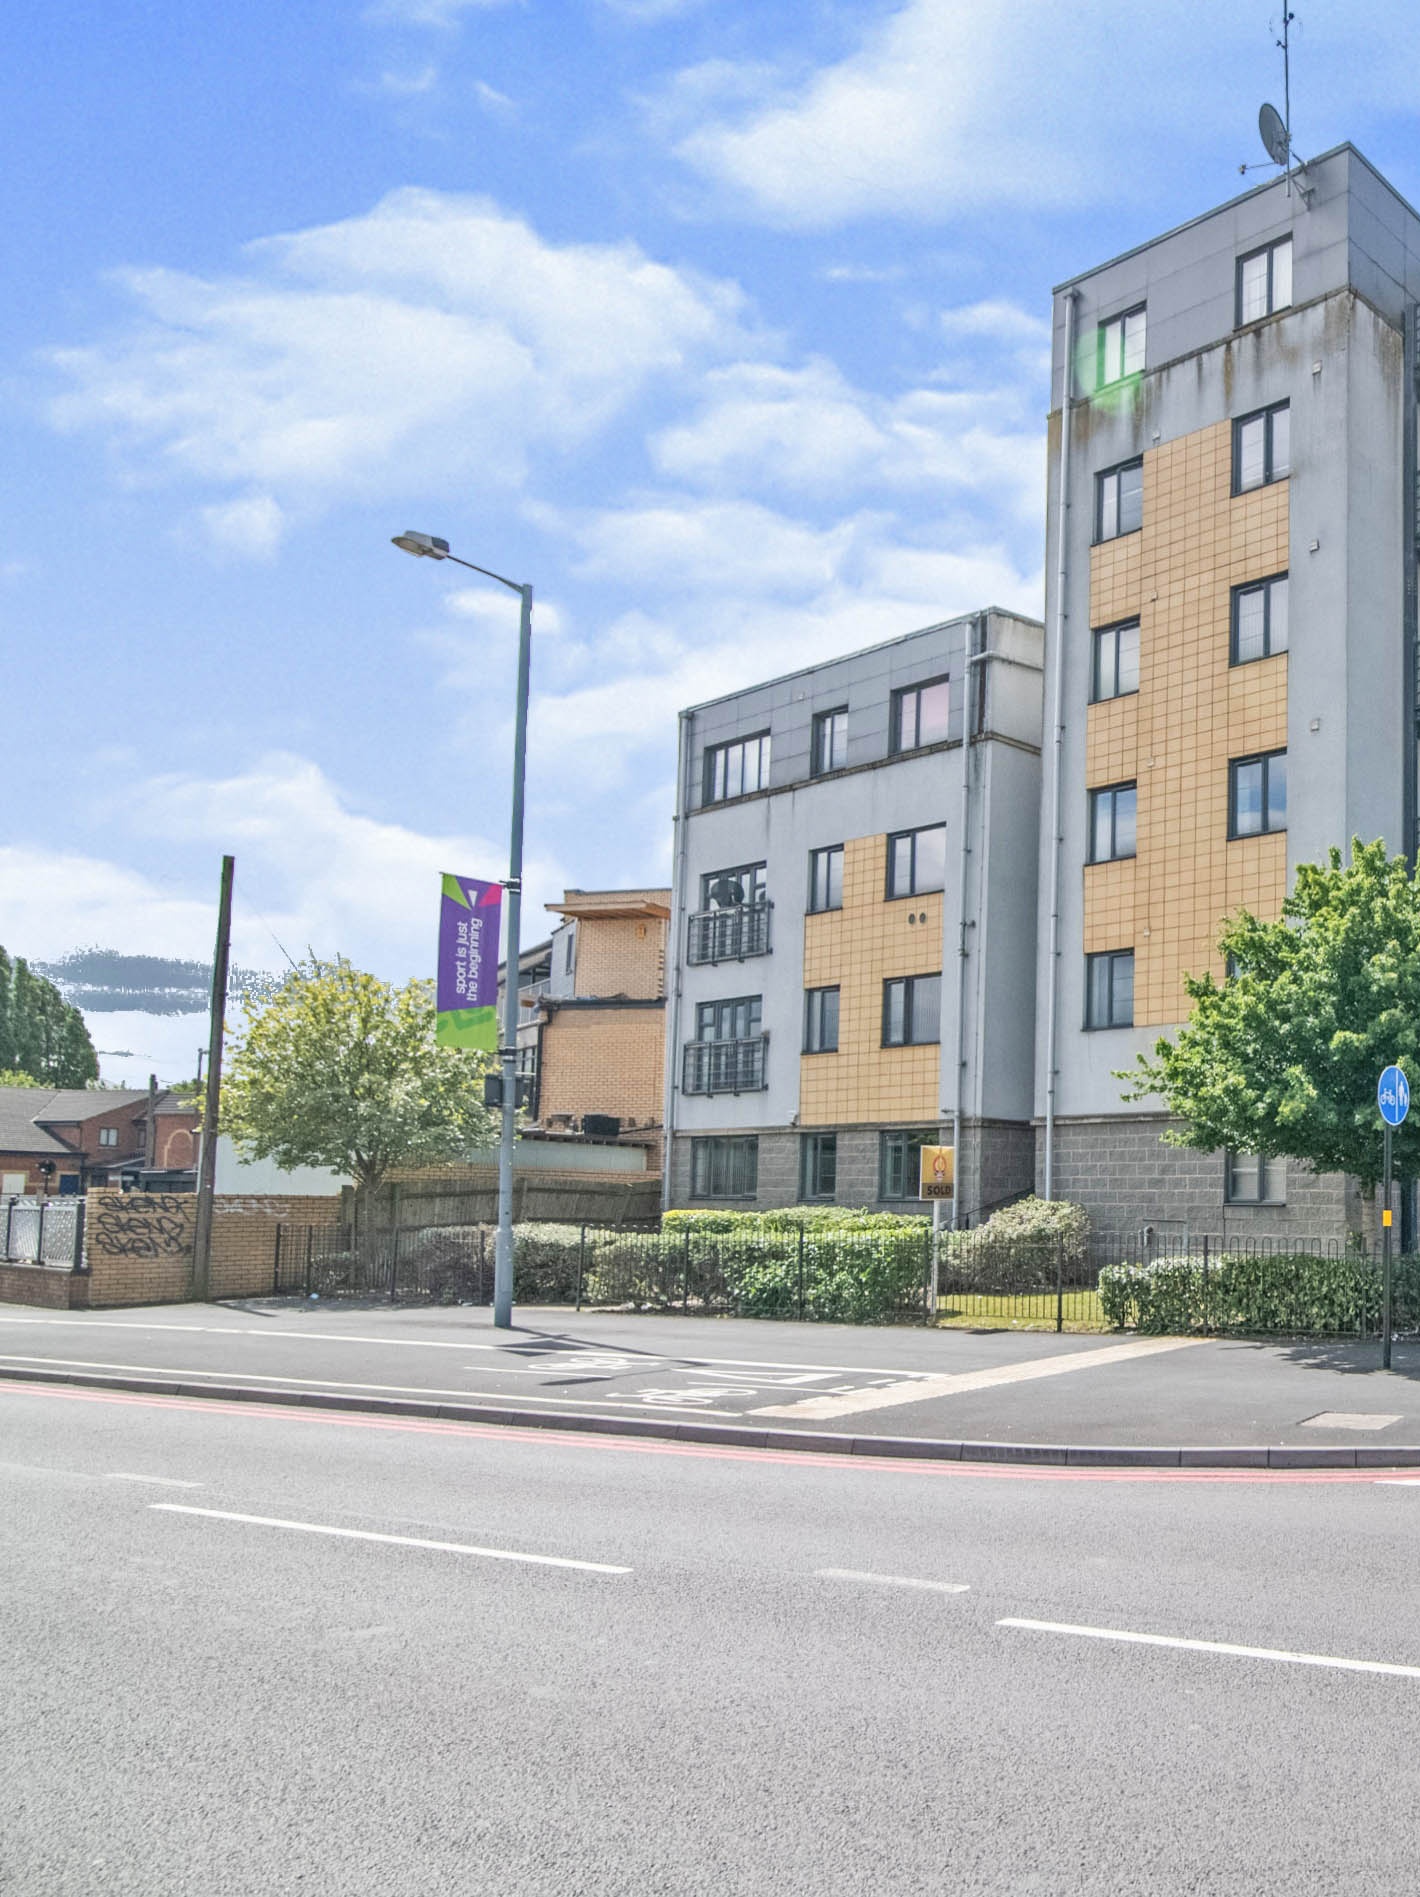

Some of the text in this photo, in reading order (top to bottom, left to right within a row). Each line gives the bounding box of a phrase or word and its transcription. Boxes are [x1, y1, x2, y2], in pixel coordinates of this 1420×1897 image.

[456, 922, 468, 994] sport is just
[467, 918, 483, 1001] the beginning
[927, 1185, 951, 1196] SOLD
